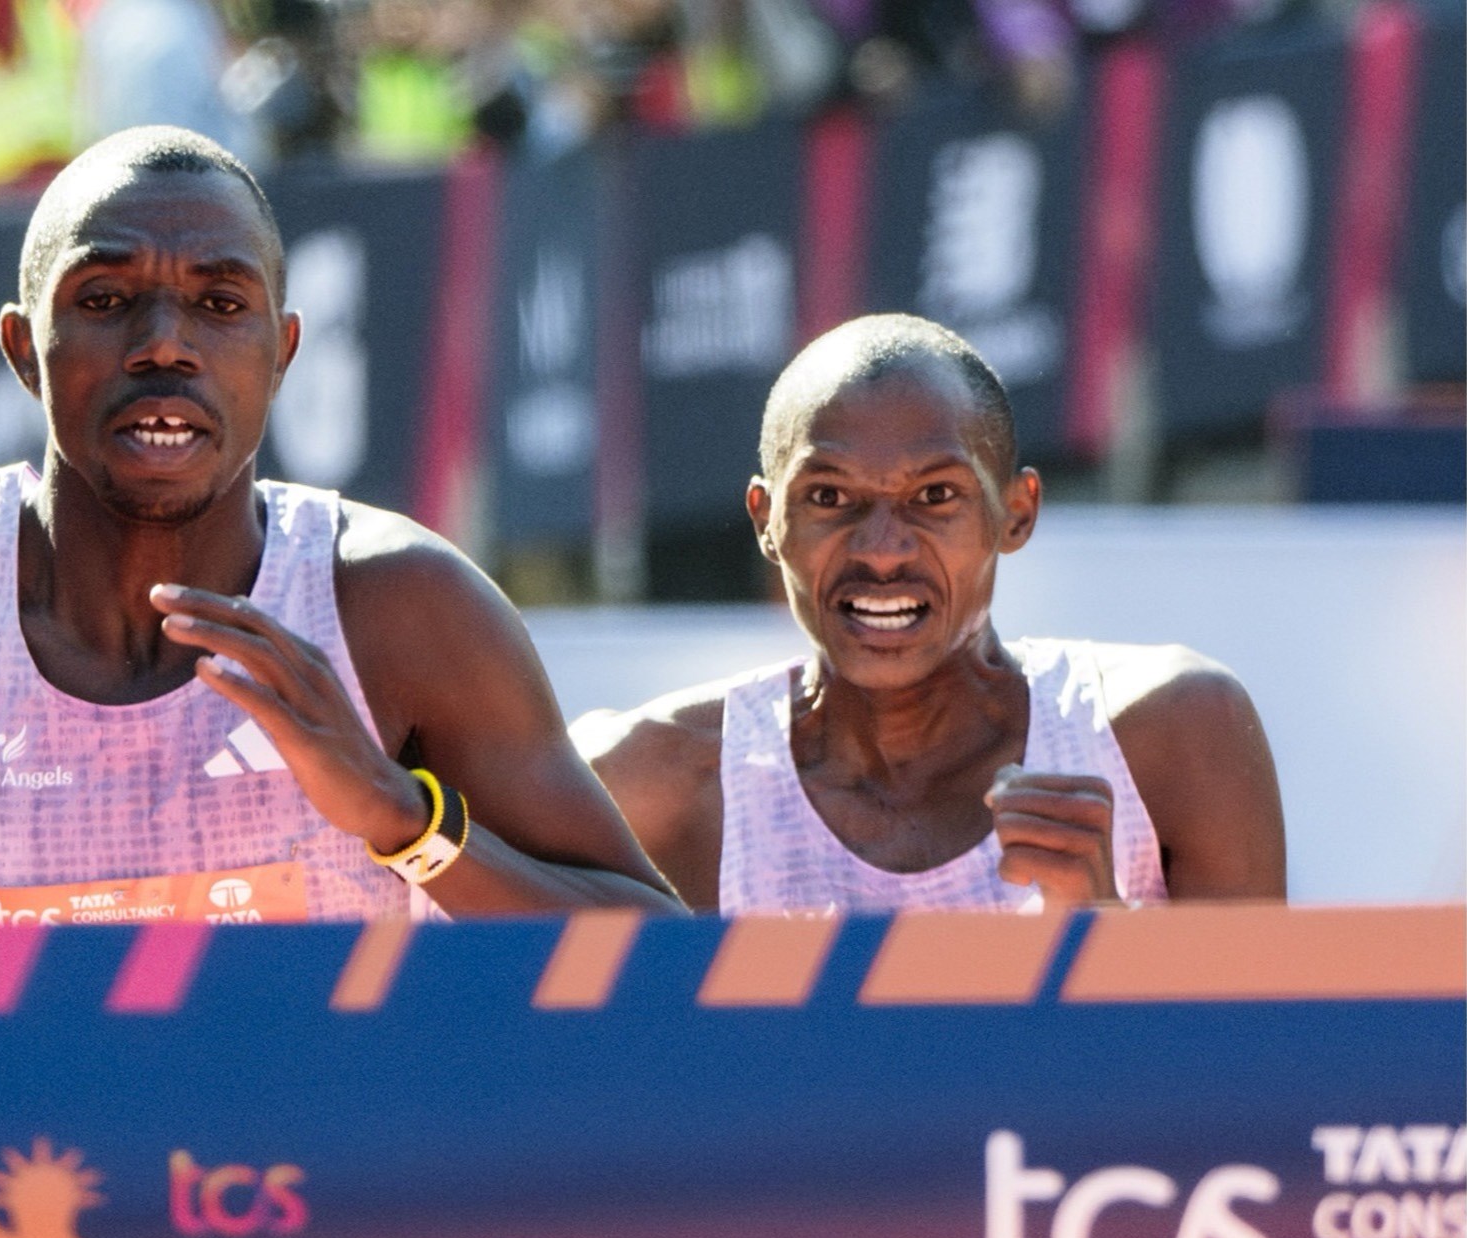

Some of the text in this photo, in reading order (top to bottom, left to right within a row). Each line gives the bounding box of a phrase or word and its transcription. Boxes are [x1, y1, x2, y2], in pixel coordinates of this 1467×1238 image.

[1, 765, 73, 790] Angels
[69, 892, 115, 909] TATA
[72, 904, 175, 925] CONSULTANCY
[170, 1149, 307, 1235] tcs
